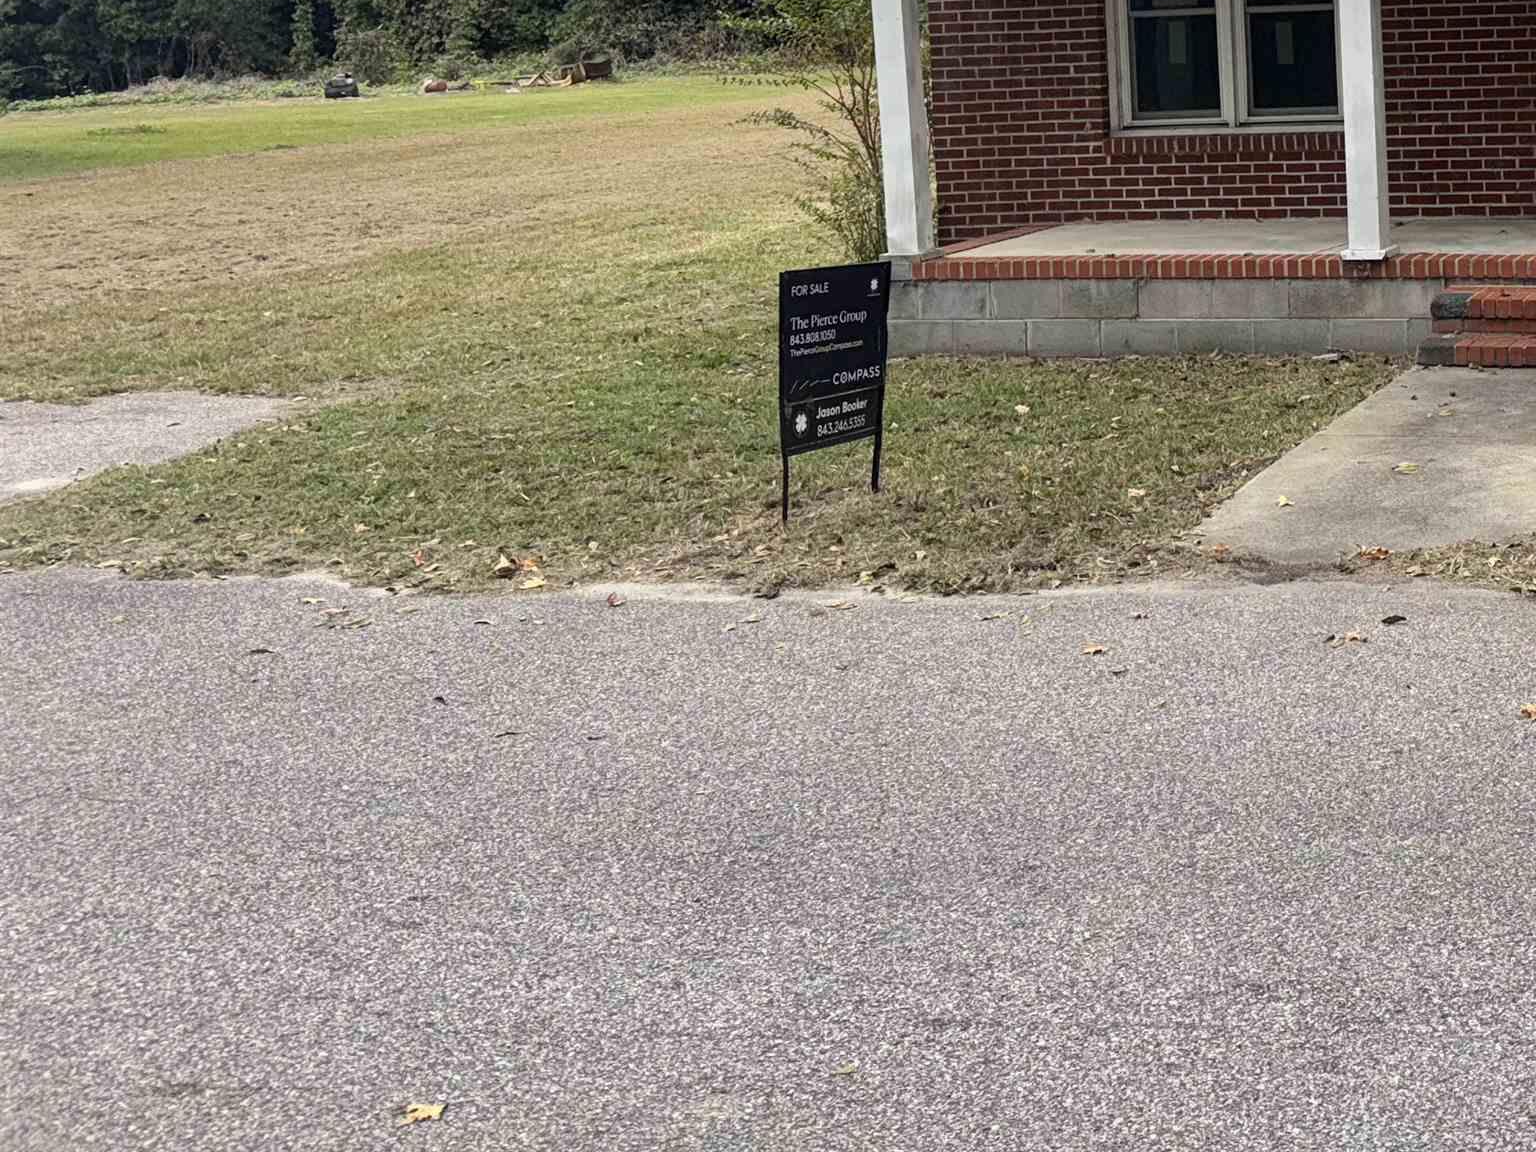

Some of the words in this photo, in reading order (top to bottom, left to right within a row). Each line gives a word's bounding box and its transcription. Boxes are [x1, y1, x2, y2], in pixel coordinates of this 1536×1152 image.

[791, 284, 808, 297] FOR
[809, 281, 830, 295] SALE
[790, 316, 809, 331] The
[811, 313, 838, 328] Pierce
[840, 310, 867, 323] Group
[789, 329, 836, 346] 843.808.1050
[832, 365, 881, 385] COMPASS
[816, 405, 840, 419] Jason
[842, 398, 868, 413] Booker
